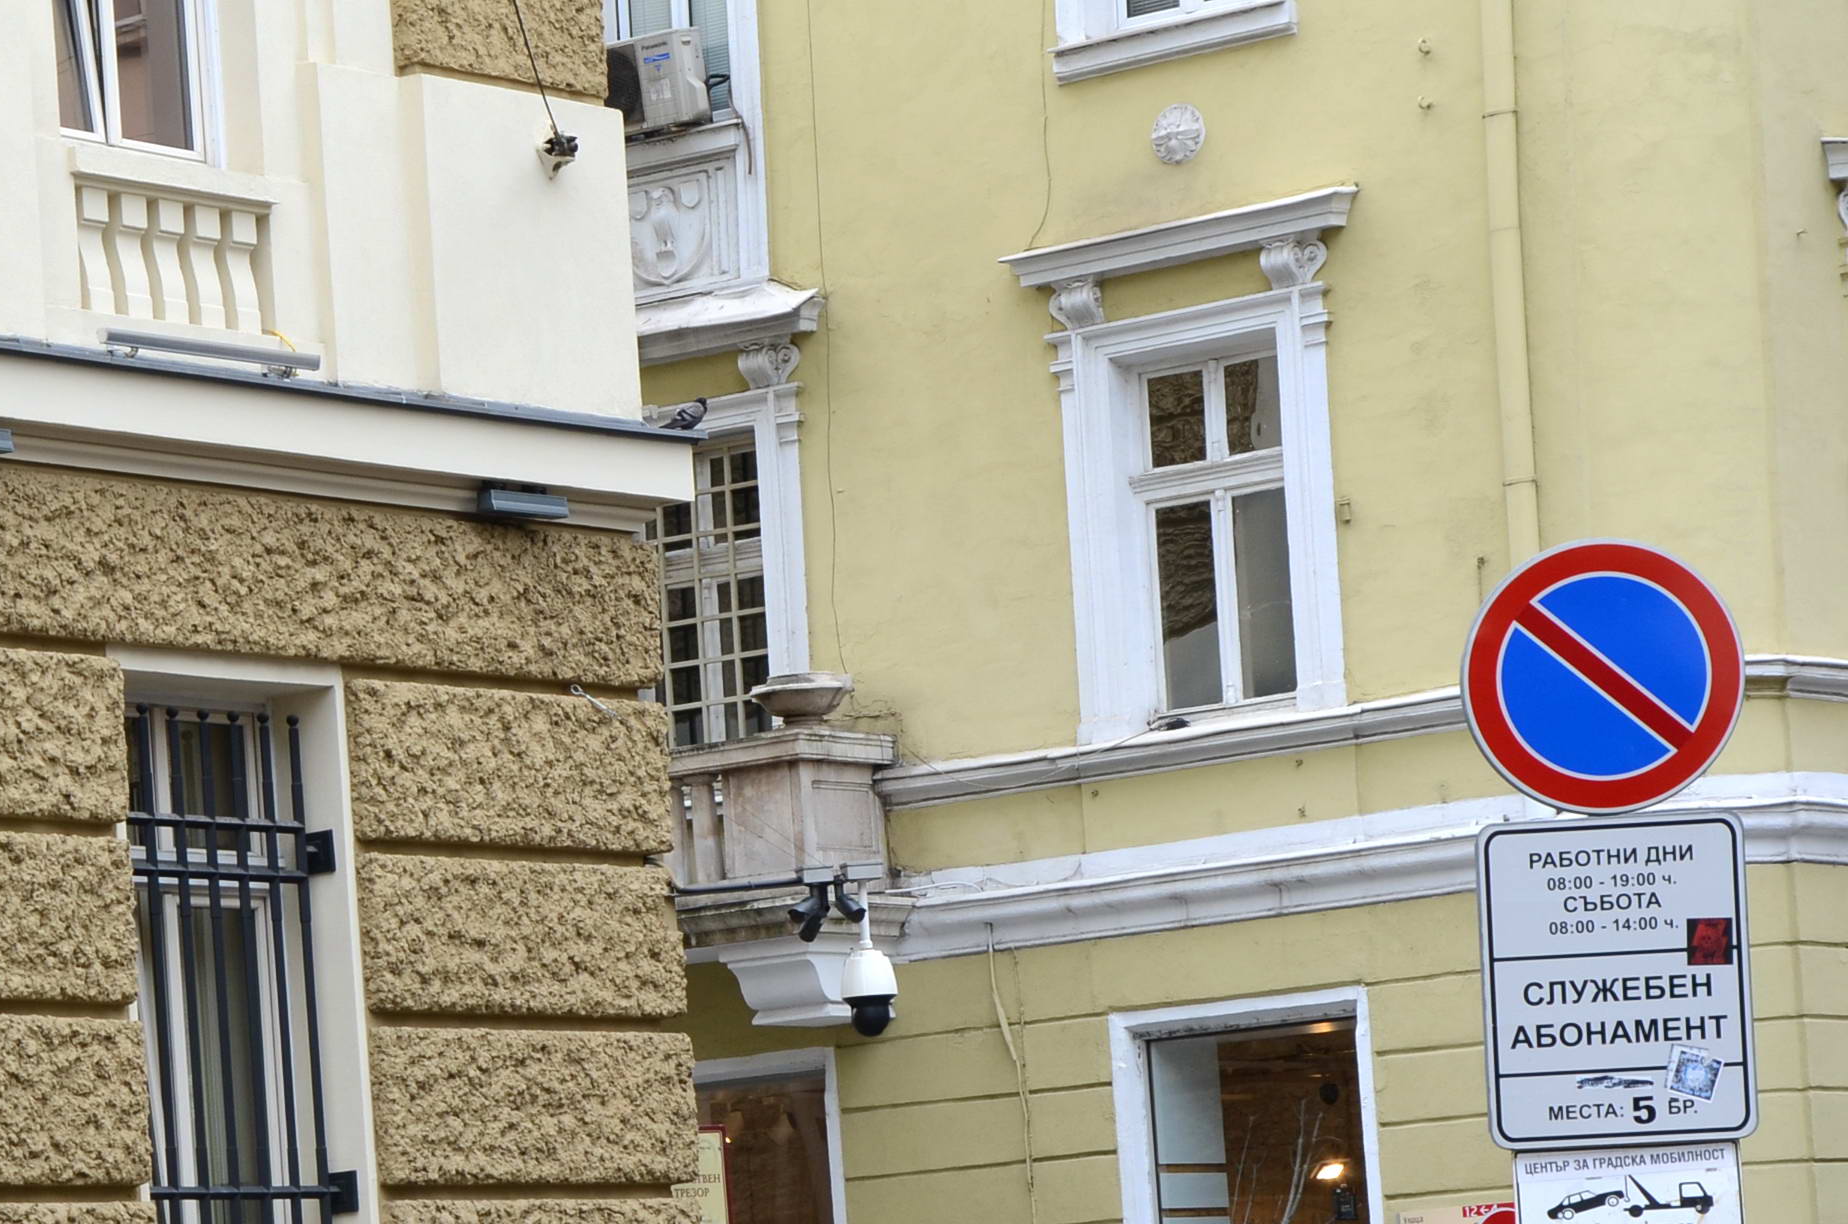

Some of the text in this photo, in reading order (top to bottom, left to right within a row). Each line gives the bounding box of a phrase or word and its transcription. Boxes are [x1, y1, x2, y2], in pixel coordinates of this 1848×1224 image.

[1529, 844, 1693, 870] РАБОТНИ ДНИ
[1547, 875, 1593, 891] 08:00
[1610, 872, 1656, 888] 19:00
[1662, 874, 1677, 885] ч.
[1563, 892, 1662, 913] СЪБОТА
[1549, 919, 1595, 935] 08:00
[1612, 916, 1658, 932] 14:00
[1664, 919, 1679, 929] ч.
[1523, 973, 1713, 1006] СЛУЖЕБЕН
[1510, 1015, 1728, 1049] АБОНАМЕНТ
[1548, 1095, 1699, 1124] МЕСТА: 5 БР.
[1525, 1148, 1726, 1175] ЦЕНТЪР ЗА ГРАДСКА МОБИЛНОСТ
[674, 1187, 710, 1199] ТРЕЗОР
[1464, 1205, 1478, 1218] 12
